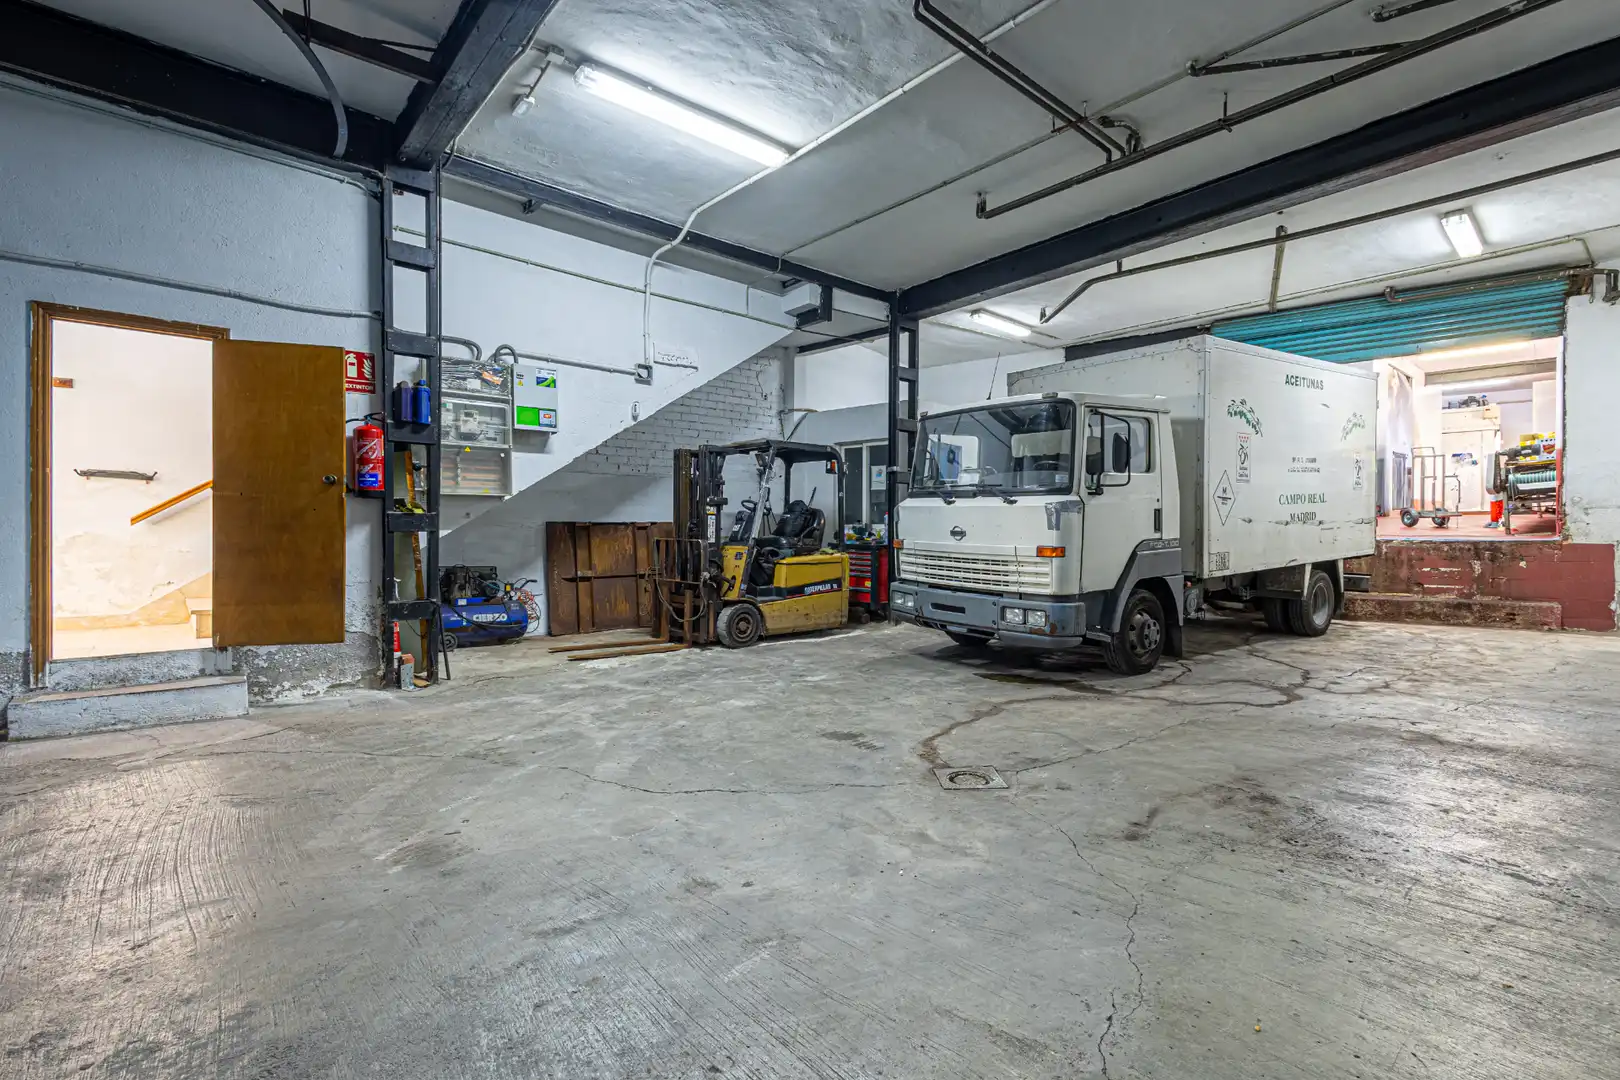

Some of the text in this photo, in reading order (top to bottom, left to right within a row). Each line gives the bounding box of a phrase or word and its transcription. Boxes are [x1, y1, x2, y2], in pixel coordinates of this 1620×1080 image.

[1285, 374, 1324, 390] ACEITUNAS
[1279, 493, 1326, 505] CAMPO REAL
[1290, 512, 1316, 522] MADRID
